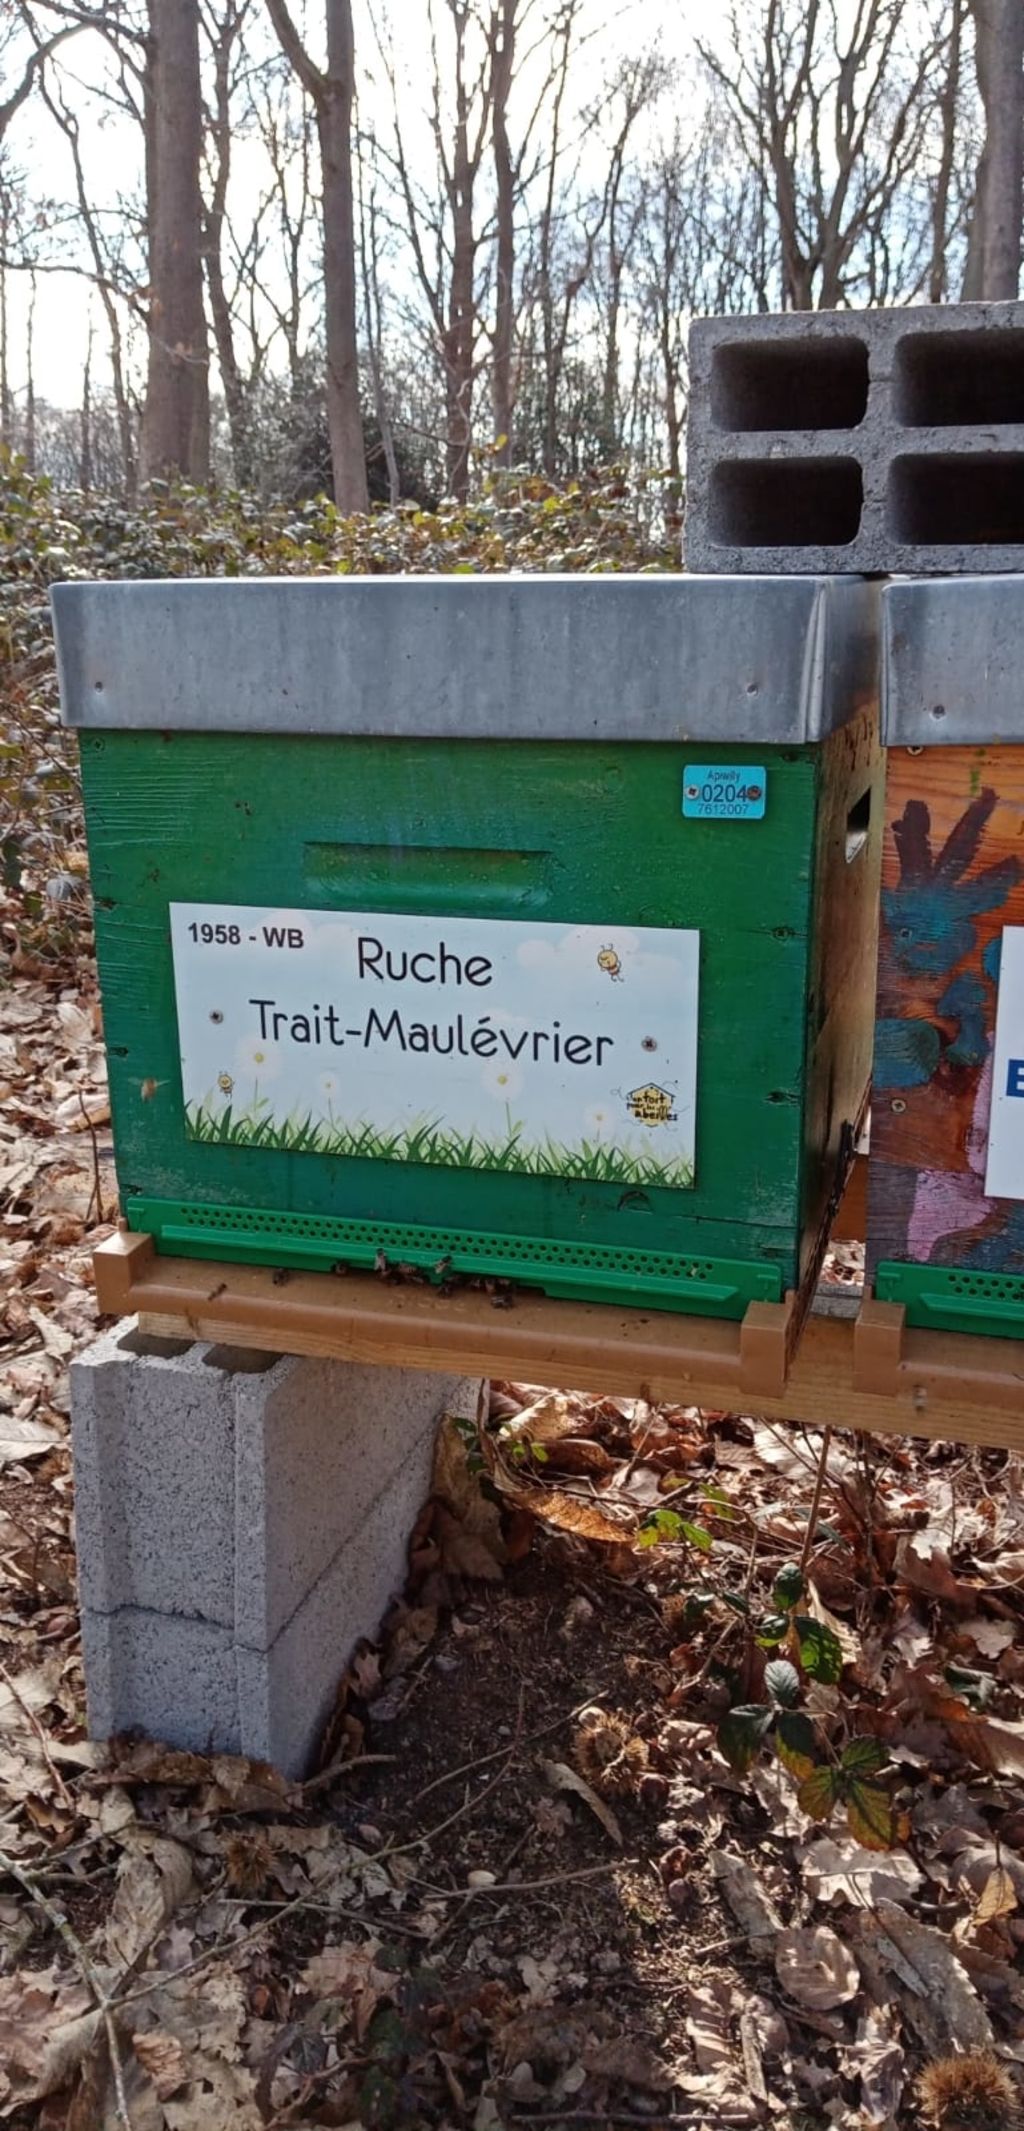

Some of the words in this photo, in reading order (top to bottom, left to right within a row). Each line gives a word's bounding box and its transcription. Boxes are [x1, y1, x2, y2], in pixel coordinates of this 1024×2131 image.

[702, 784, 748, 802] 0204
[698, 803, 749, 815] 7612007
[188, 922, 241, 946] 1958
[262, 926, 305, 949] WB
[357, 936, 494, 987] Ruche
[249, 999, 614, 1066] Trait-Maulévrier
